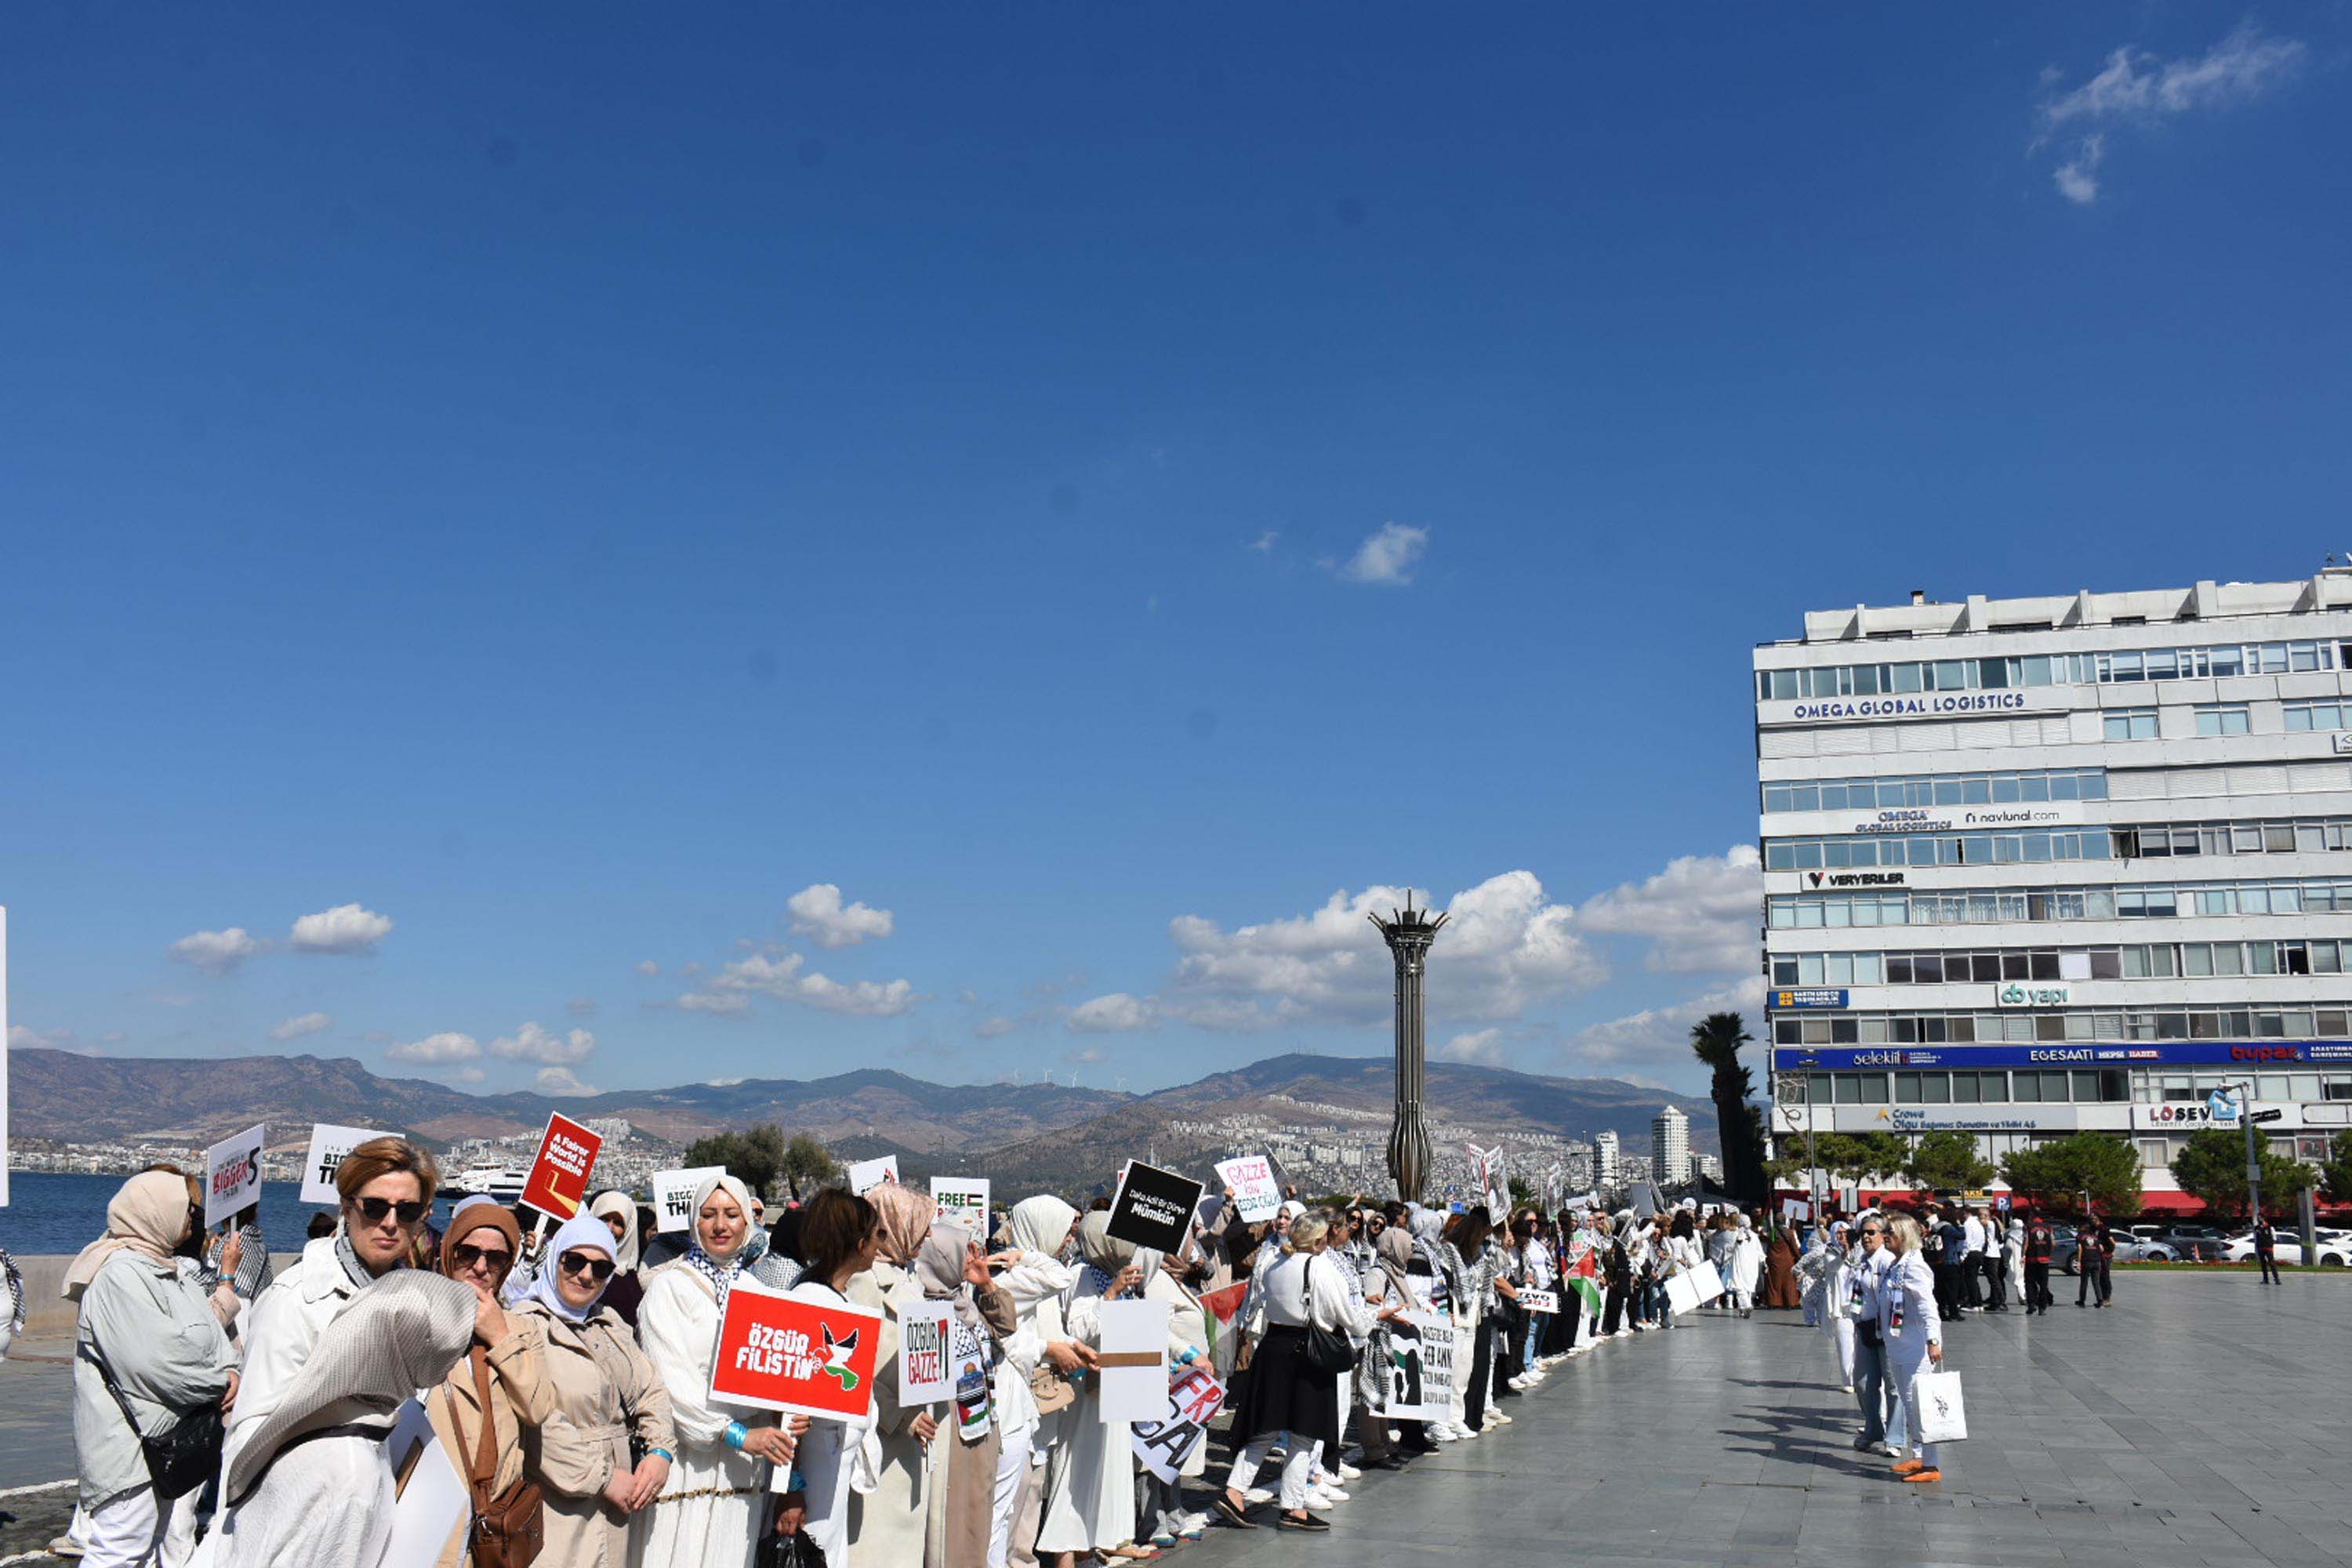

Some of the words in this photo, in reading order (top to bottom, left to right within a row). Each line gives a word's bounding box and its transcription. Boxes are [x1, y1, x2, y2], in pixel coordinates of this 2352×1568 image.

[1794, 703, 1856, 719] OMEGA
[1860, 699, 1926, 715] GLOBAL
[1934, 693, 2024, 712] LOGISTICS
[1878, 810, 1929, 822] OMEGA
[1896, 820, 1952, 831] LOGISTICS
[1893, 1109, 1925, 1119] Crowe
[550, 1141, 579, 1163] World
[553, 1133, 561, 1144] A
[561, 1136, 590, 1157] Fairer
[248, 1146, 260, 1186] 5
[544, 1150, 583, 1177] Possible
[1226, 1163, 1267, 1185] GAZZE
[213, 1160, 249, 1195] BIGGER
[938, 1192, 966, 1207] FREE
[1998, 1197, 2006, 1210] P
[1131, 1202, 1176, 1226] Mümkün
[749, 1322, 809, 1357] ÖZGÜR
[906, 1316, 938, 1352] ÖZGÜR
[735, 1346, 814, 1381] FİLİSTİN
[908, 1352, 938, 1385] GAZZE
